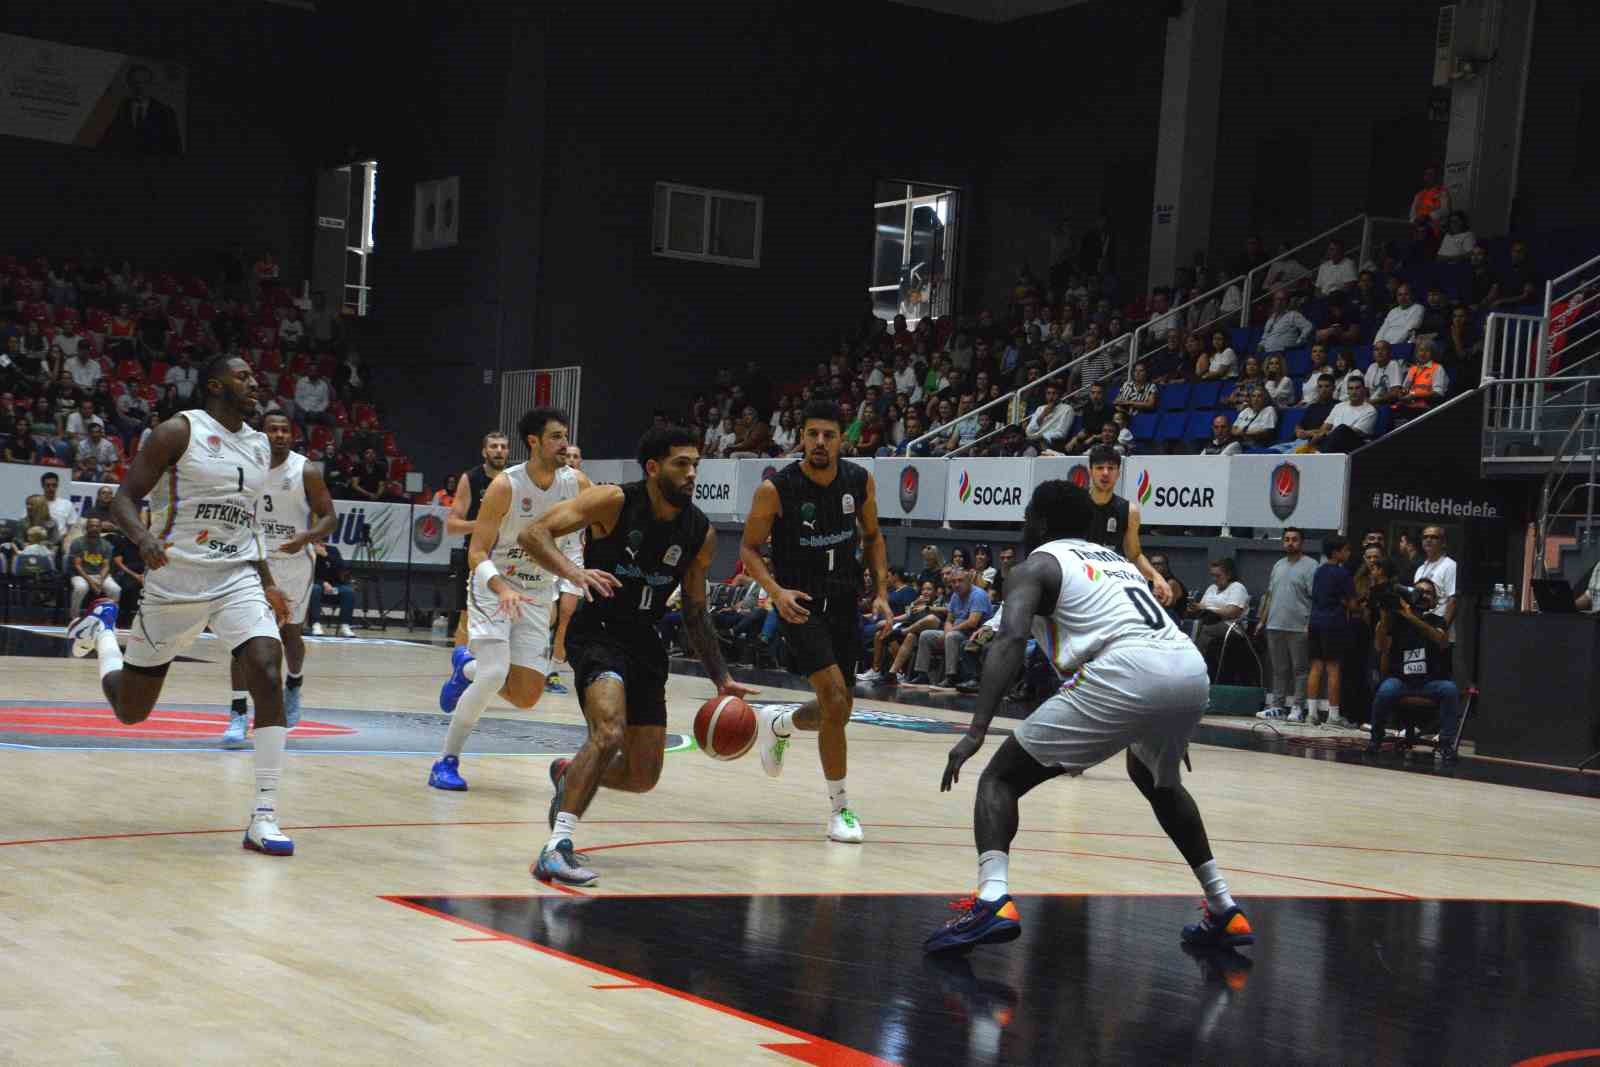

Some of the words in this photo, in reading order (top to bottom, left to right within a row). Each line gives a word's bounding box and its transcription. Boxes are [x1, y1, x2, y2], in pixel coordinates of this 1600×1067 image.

[236, 466, 244, 492] 1
[263, 494, 273, 512] 3
[695, 484, 730, 500] SOCAR
[973, 486, 1022, 505] SOCAR
[1154, 486, 1214, 508] SOCAR
[1372, 492, 1497, 518] #BirlikteHedefe
[825, 548, 836, 572] 1
[1124, 587, 1166, 631] 0
